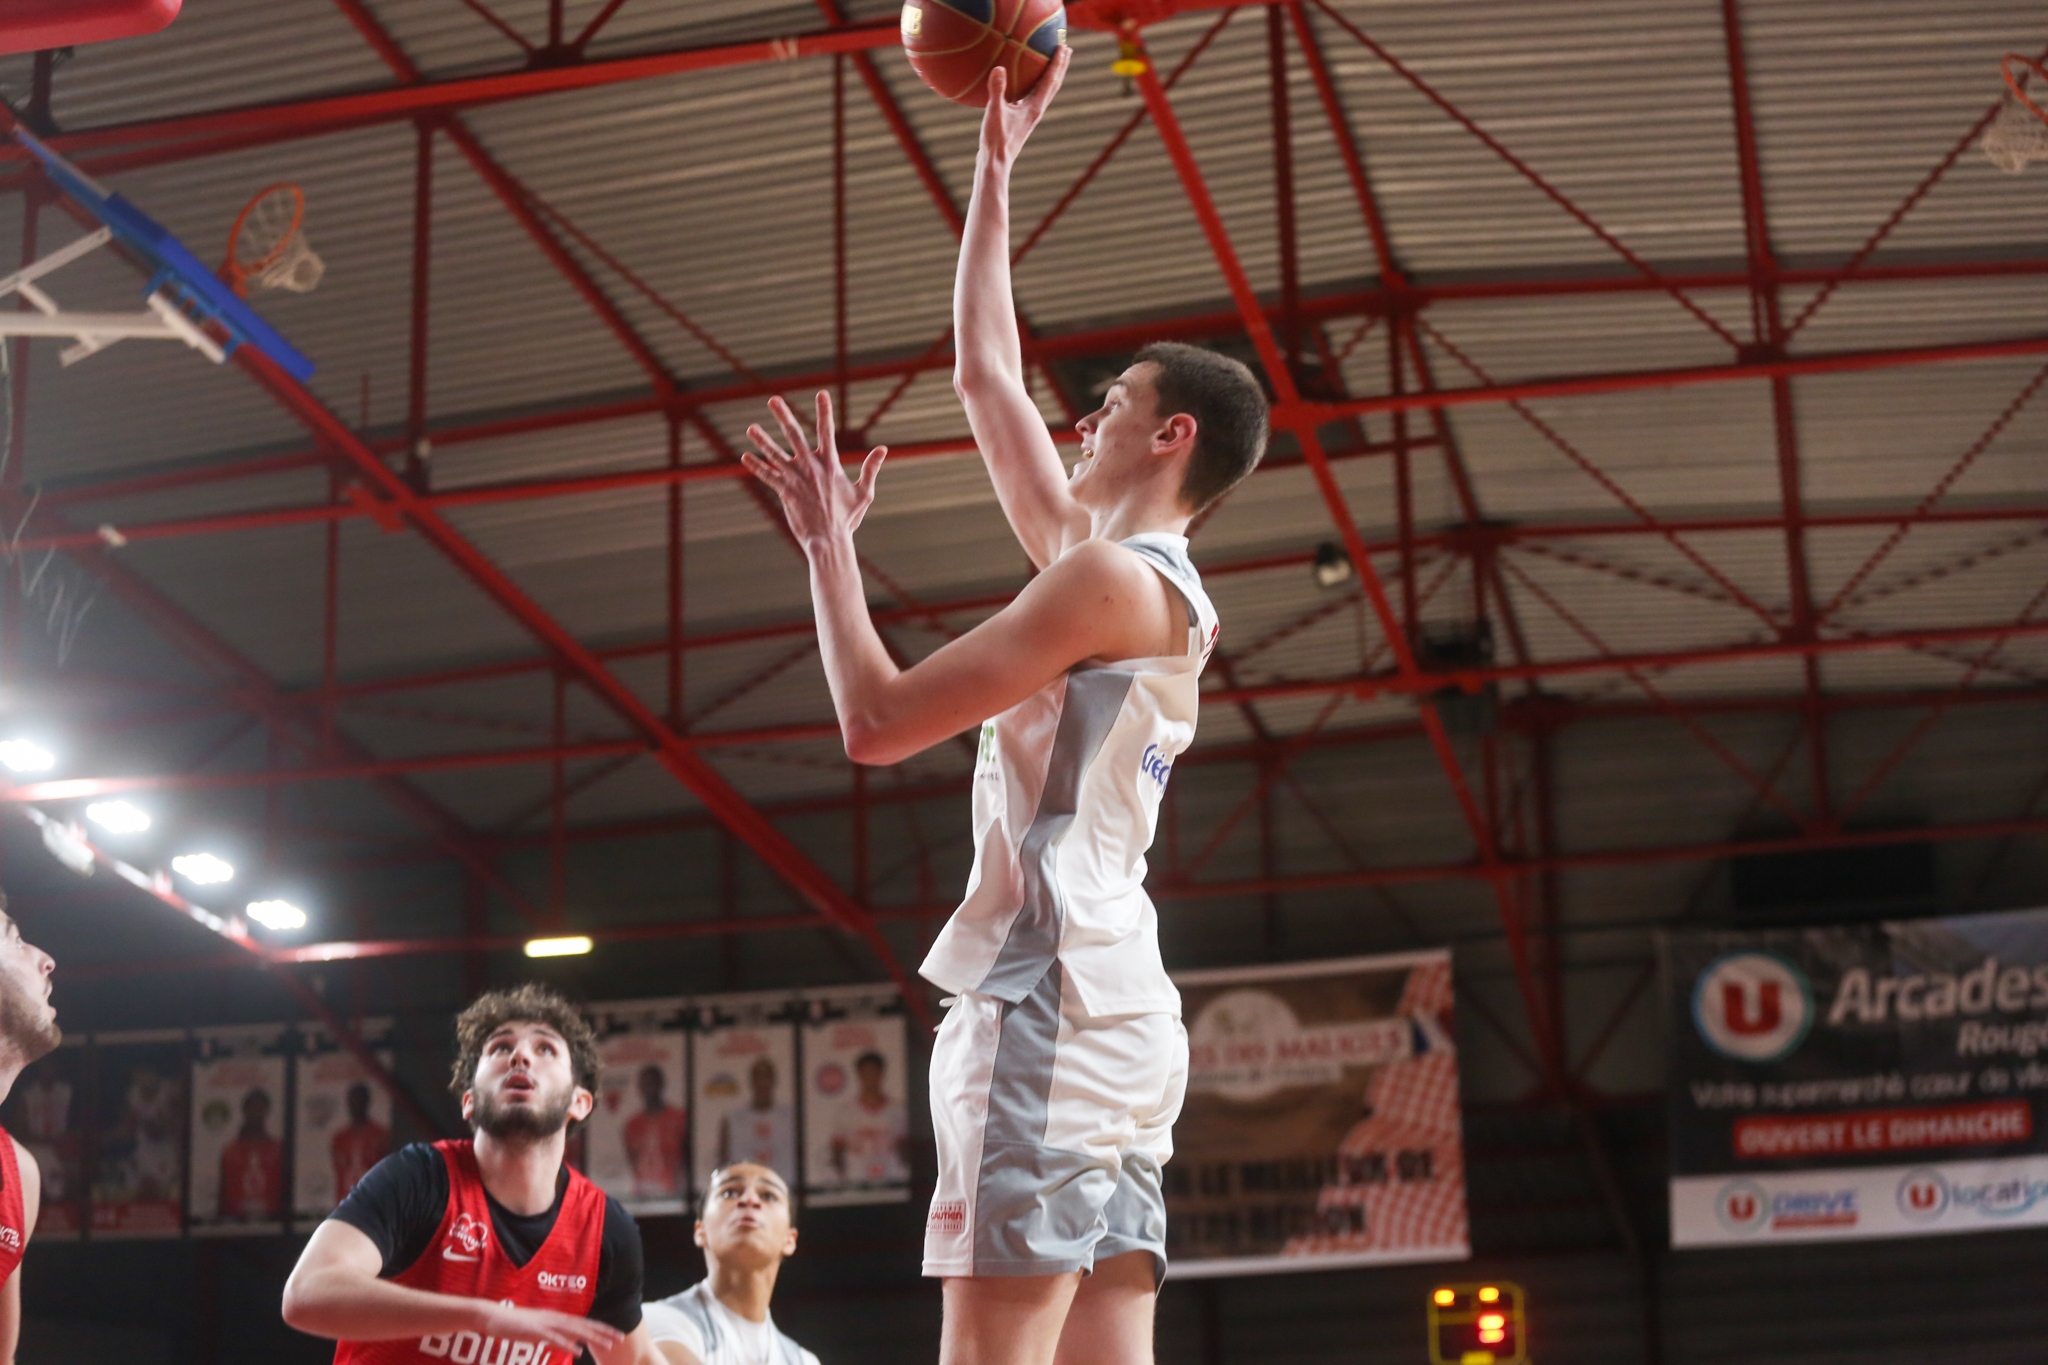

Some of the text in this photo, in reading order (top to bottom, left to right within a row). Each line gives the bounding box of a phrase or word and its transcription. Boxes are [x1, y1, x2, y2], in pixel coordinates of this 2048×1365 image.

[1723, 959, 2048, 1035] U Arcades
[1739, 1106, 2024, 1154] OUVERT LE DIMANCHE
[1772, 1187, 1858, 1214] DRIVE
[536, 1270, 587, 1290] OKTEO
